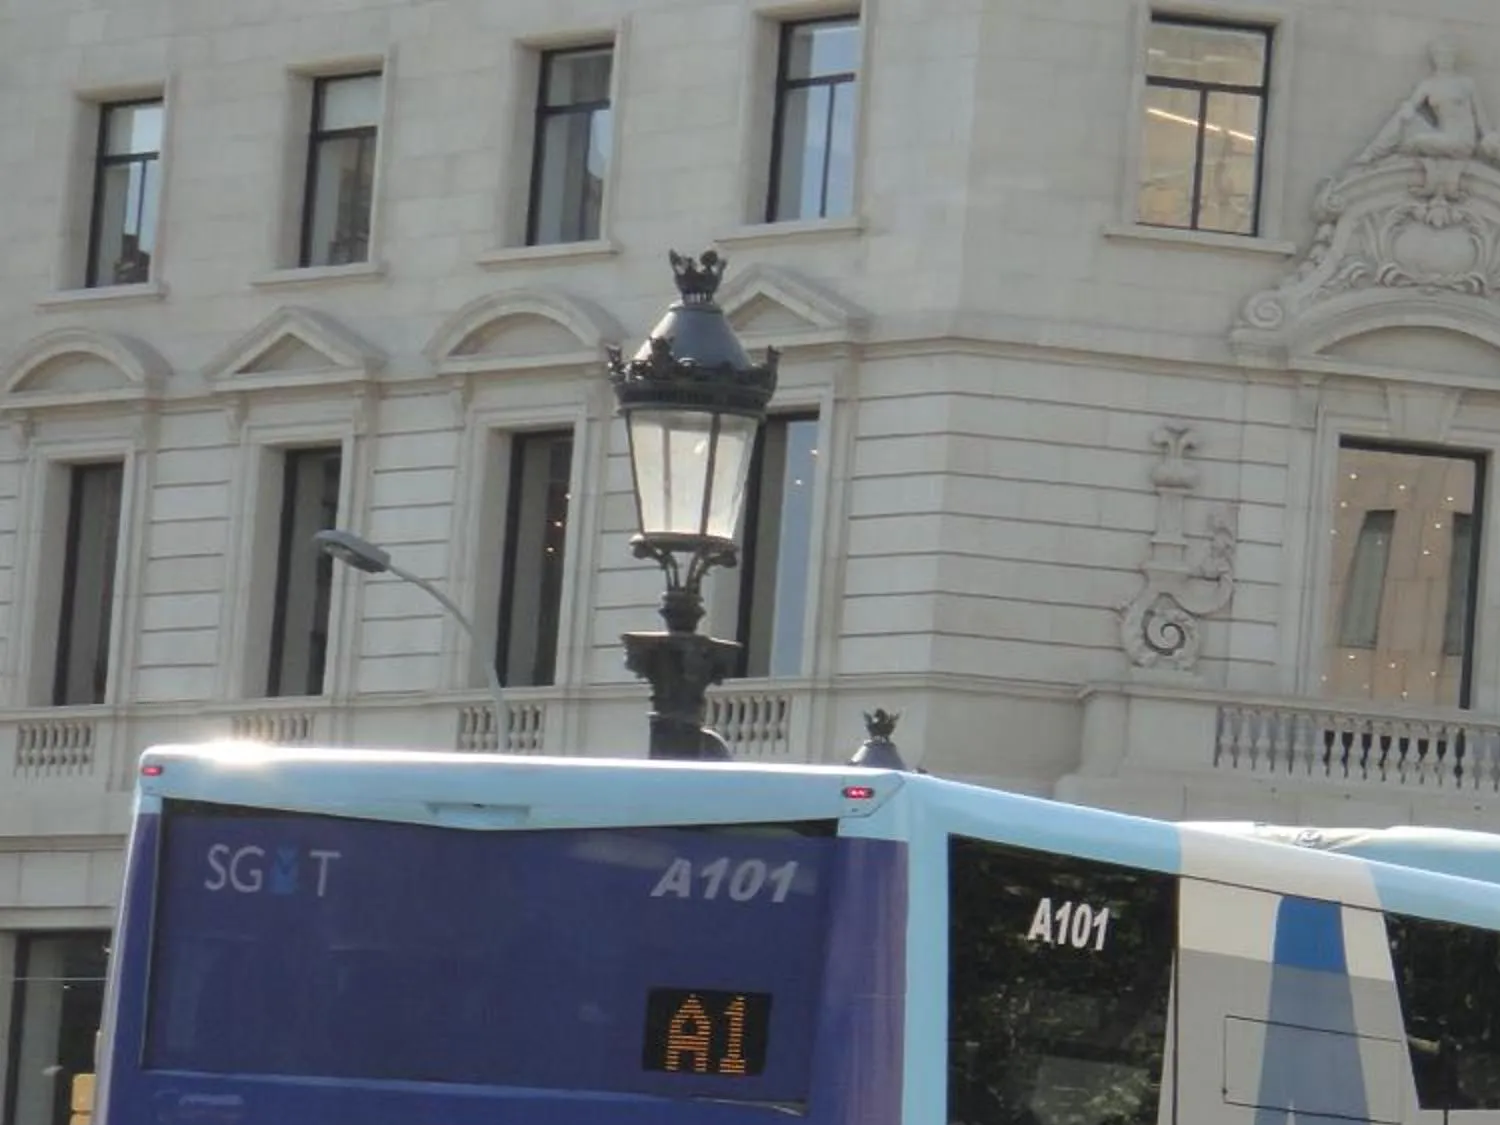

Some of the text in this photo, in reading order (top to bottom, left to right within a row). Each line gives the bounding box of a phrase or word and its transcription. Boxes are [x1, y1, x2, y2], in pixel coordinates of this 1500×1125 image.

[650, 857, 799, 903] A101
[1027, 897, 1110, 952] A101
[665, 993, 746, 1074] A1
